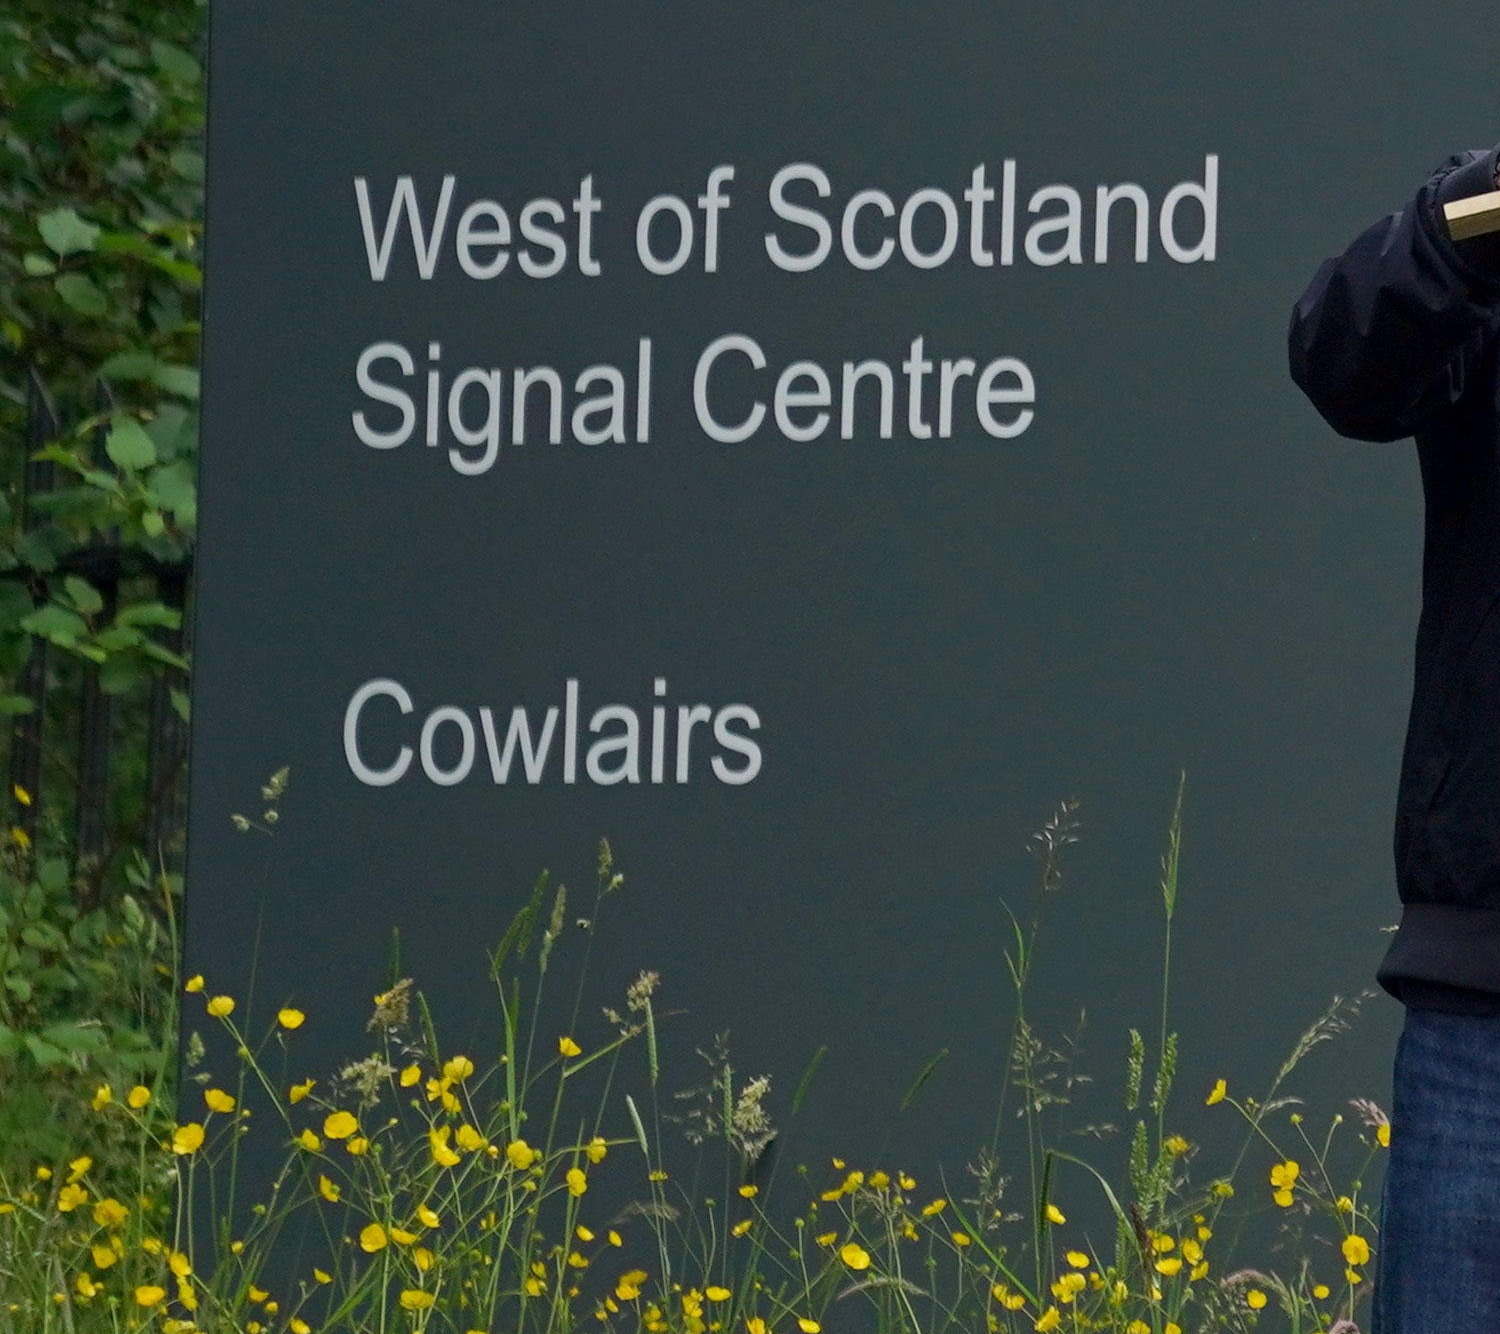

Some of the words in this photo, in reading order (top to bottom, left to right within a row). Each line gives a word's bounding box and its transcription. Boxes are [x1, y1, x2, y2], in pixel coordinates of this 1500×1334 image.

[354, 175, 602, 280] West
[636, 167, 735, 275] of
[764, 154, 1219, 272] Scotland
[352, 339, 653, 475] Signal
[693, 335, 1036, 443] Centre
[342, 679, 763, 786] Cowlairs
